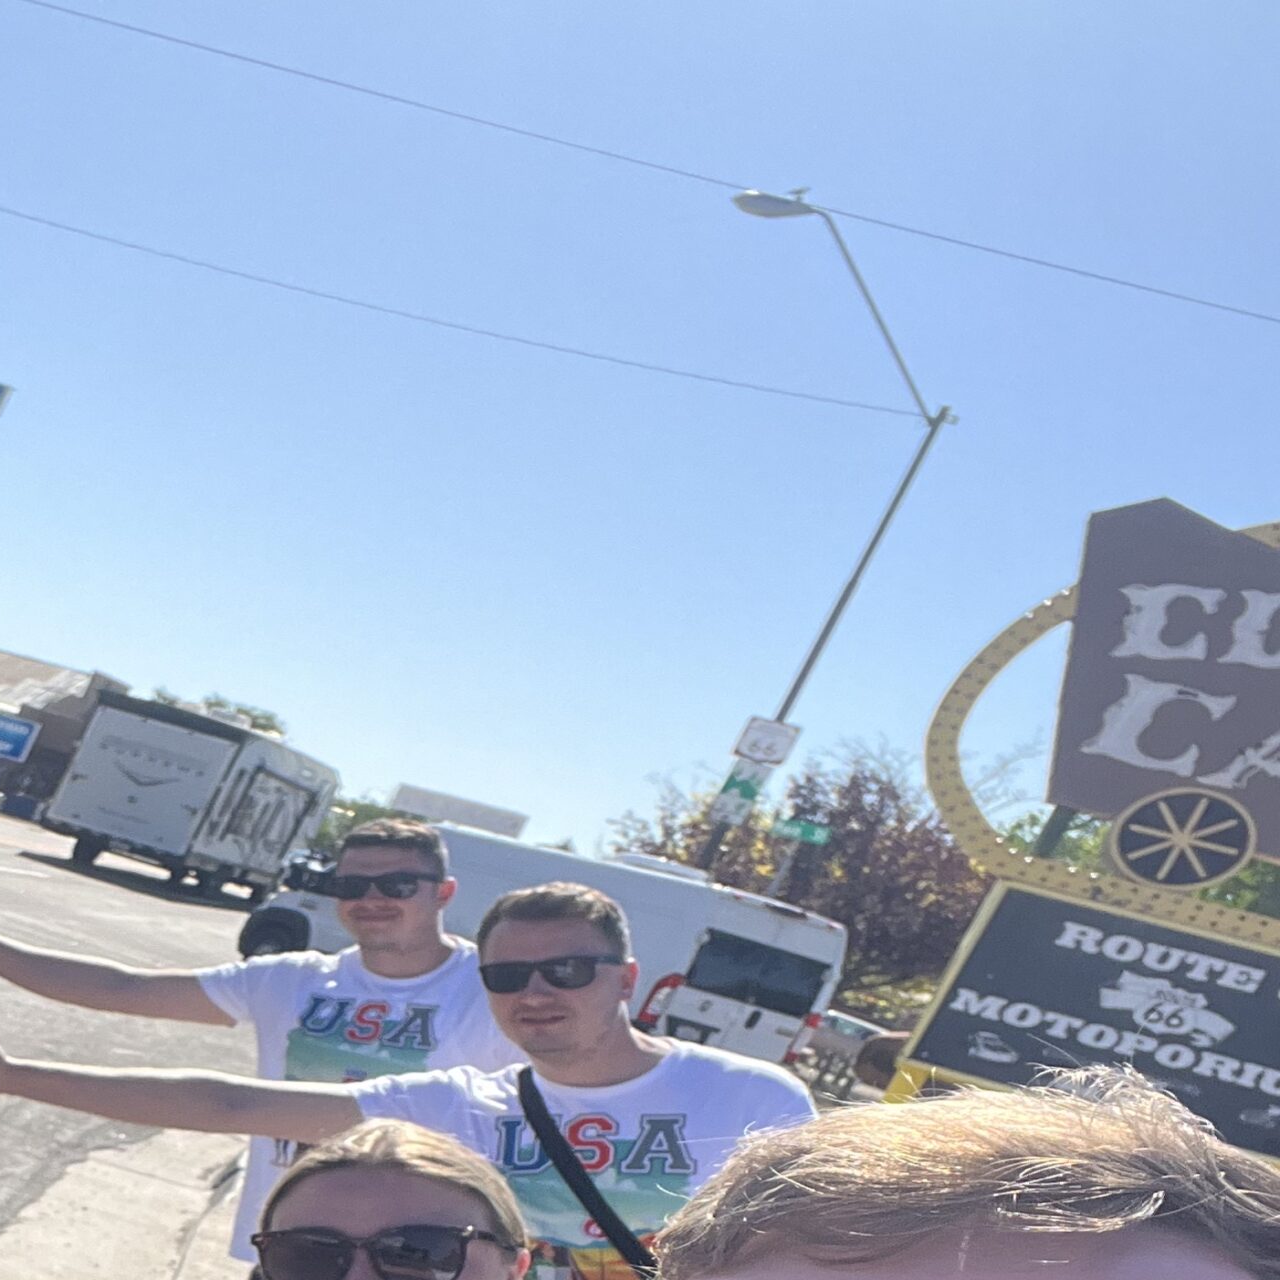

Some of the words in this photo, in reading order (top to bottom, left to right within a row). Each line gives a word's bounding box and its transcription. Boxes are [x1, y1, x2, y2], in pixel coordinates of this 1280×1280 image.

[1054, 921, 1266, 994] ROUTE
[300, 994, 440, 1051] USA
[1144, 1001, 1185, 1028] 66
[496, 1112, 696, 1176] USA
